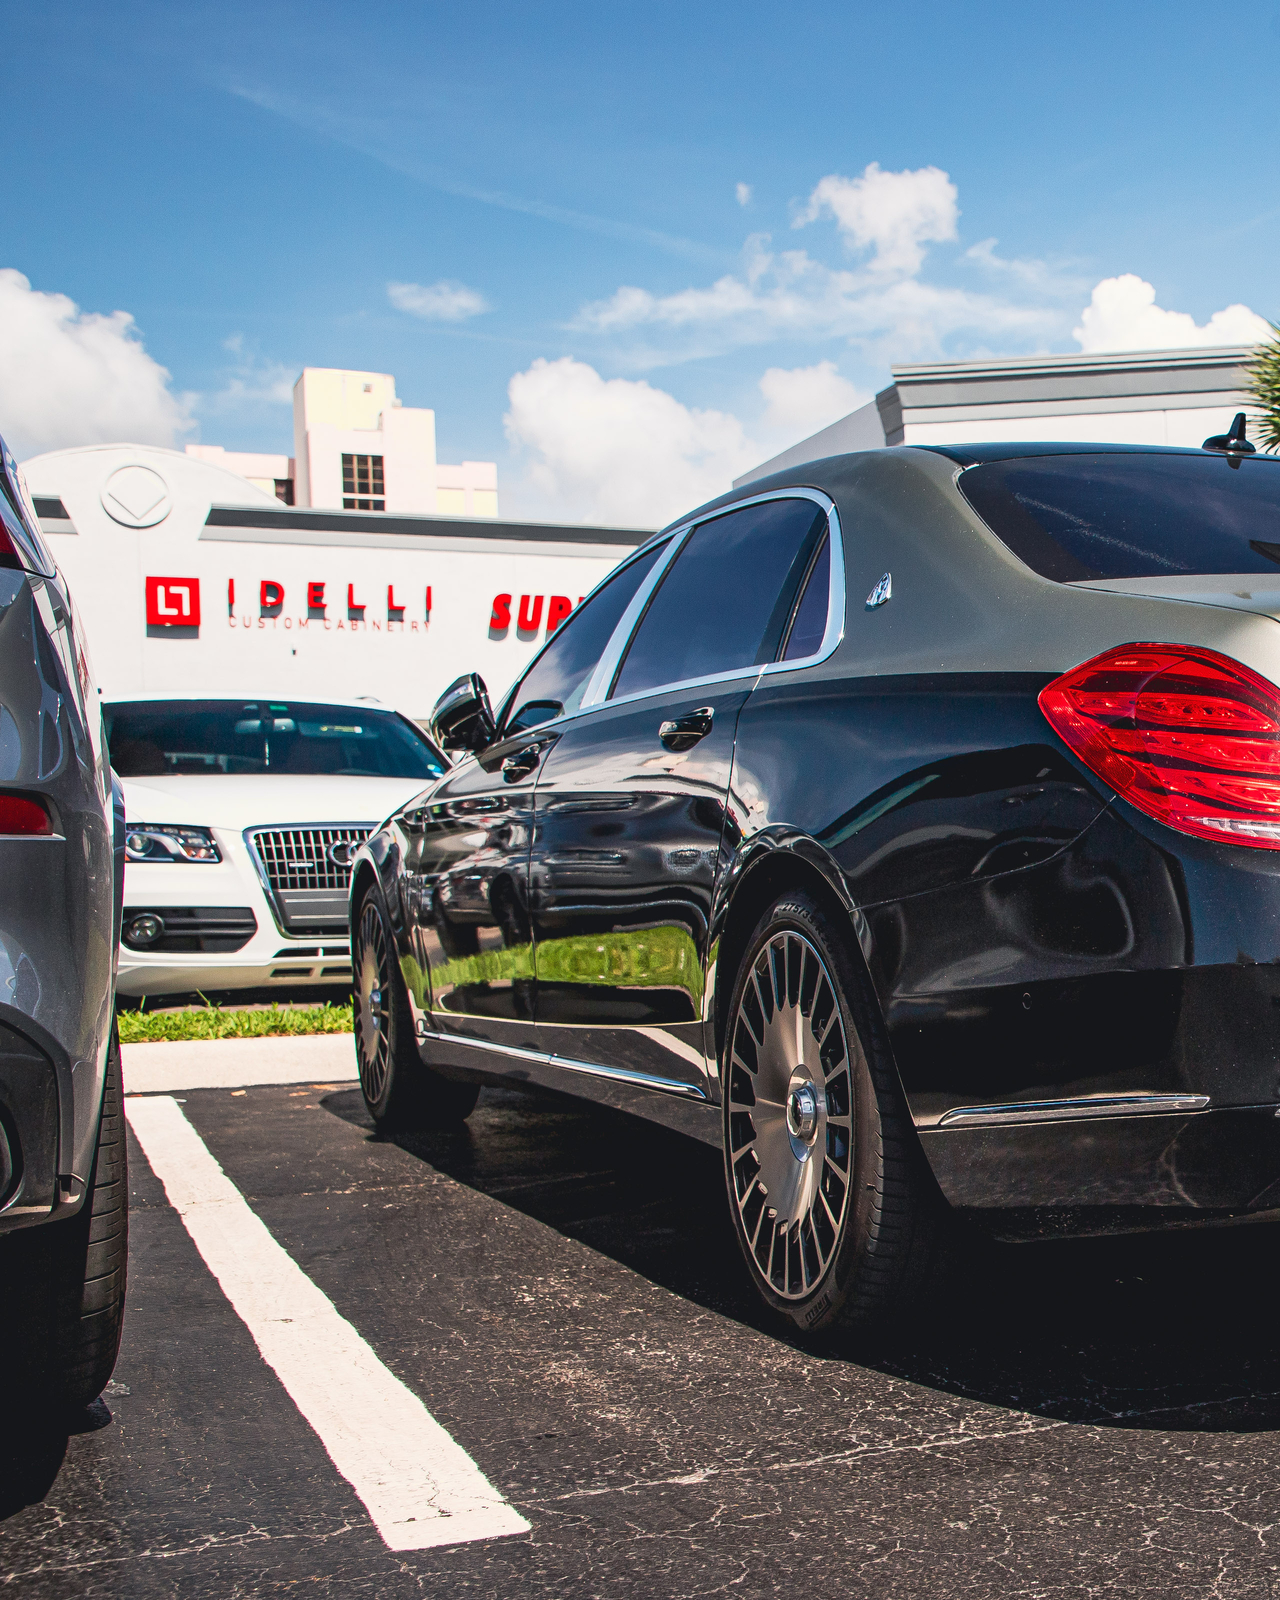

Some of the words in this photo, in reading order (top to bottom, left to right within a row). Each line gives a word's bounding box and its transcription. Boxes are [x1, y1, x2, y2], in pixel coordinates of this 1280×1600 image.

[227, 578, 432, 612] IDELLI
[489, 593, 588, 631] SUP
[228, 615, 310, 630] CUSTOM
